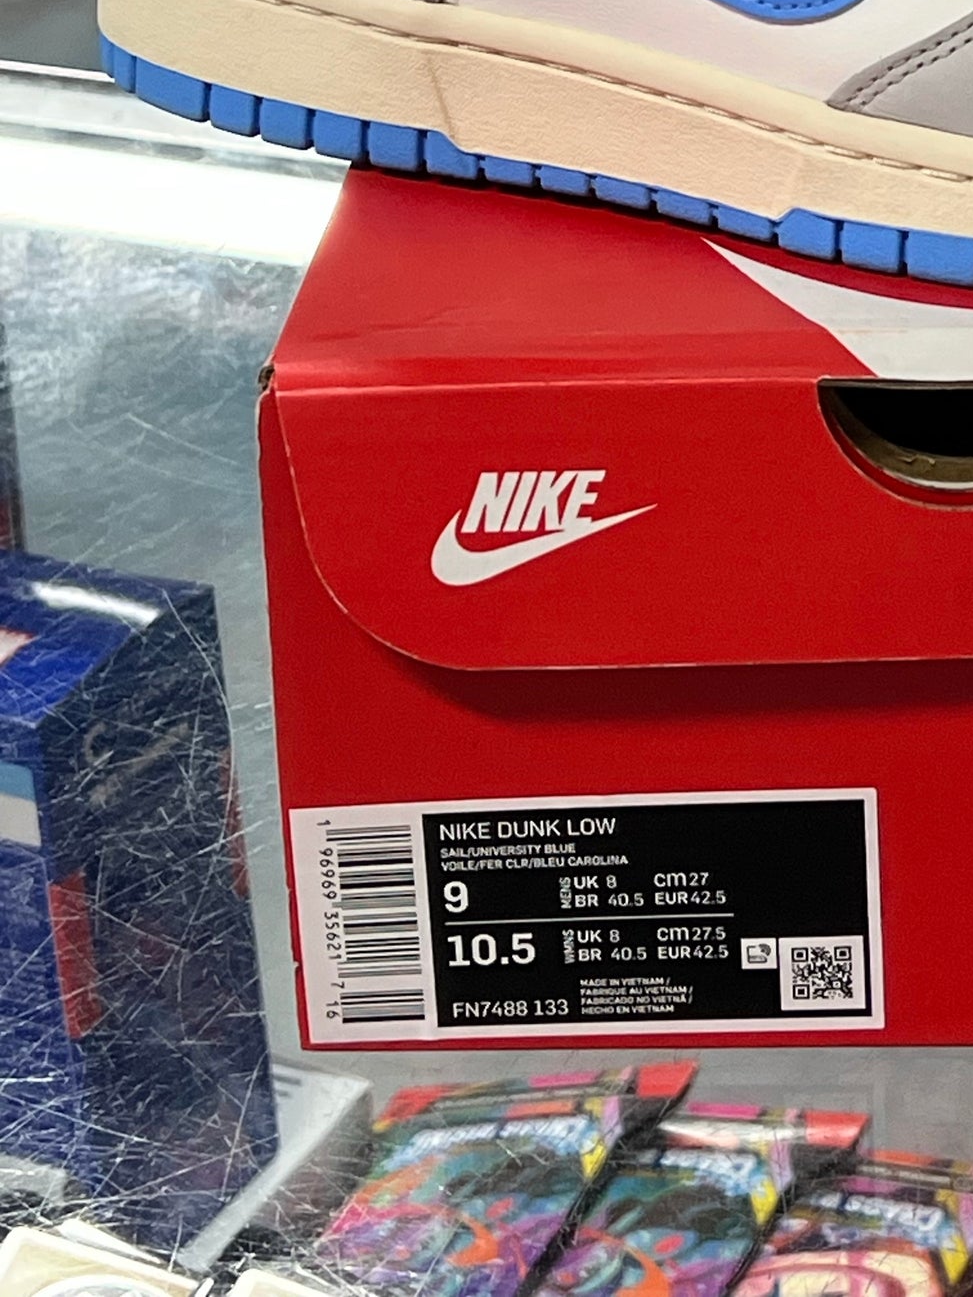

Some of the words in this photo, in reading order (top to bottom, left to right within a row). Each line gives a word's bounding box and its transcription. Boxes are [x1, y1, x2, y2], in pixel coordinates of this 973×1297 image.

[460, 469, 606, 533] NIKE
[439, 822, 492, 841] NIKE
[497, 819, 561, 839] DUNK
[567, 817, 616, 836] LOW
[440, 845, 541, 859] SAIL/UNIVERSITY
[544, 842, 576, 854] BLUE
[441, 859, 503, 872] VOILE/FER
[567, 854, 629, 867] CAROLINA
[319, 848, 337, 900] 96969
[573, 875, 599, 890] UK
[606, 874, 618, 889] 8
[443, 880, 469, 914] 9
[559, 876, 572, 909] MENS
[574, 893, 599, 908] BR
[608, 892, 645, 907] 40.5
[324, 911, 342, 961] 35621
[577, 929, 602, 944] UK
[609, 928, 620, 943] 8
[447, 933, 536, 967] 10.5
[578, 947, 602, 962] BR
[610, 946, 647, 961] 40.5
[580, 979, 607, 987] MADE
[453, 1002, 528, 1018] FN7488
[533, 1000, 569, 1016] 133
[581, 1006, 615, 1015] HECHO
[616, 1005, 630, 1014] EN
[632, 1005, 674, 1014] VIETNAM
